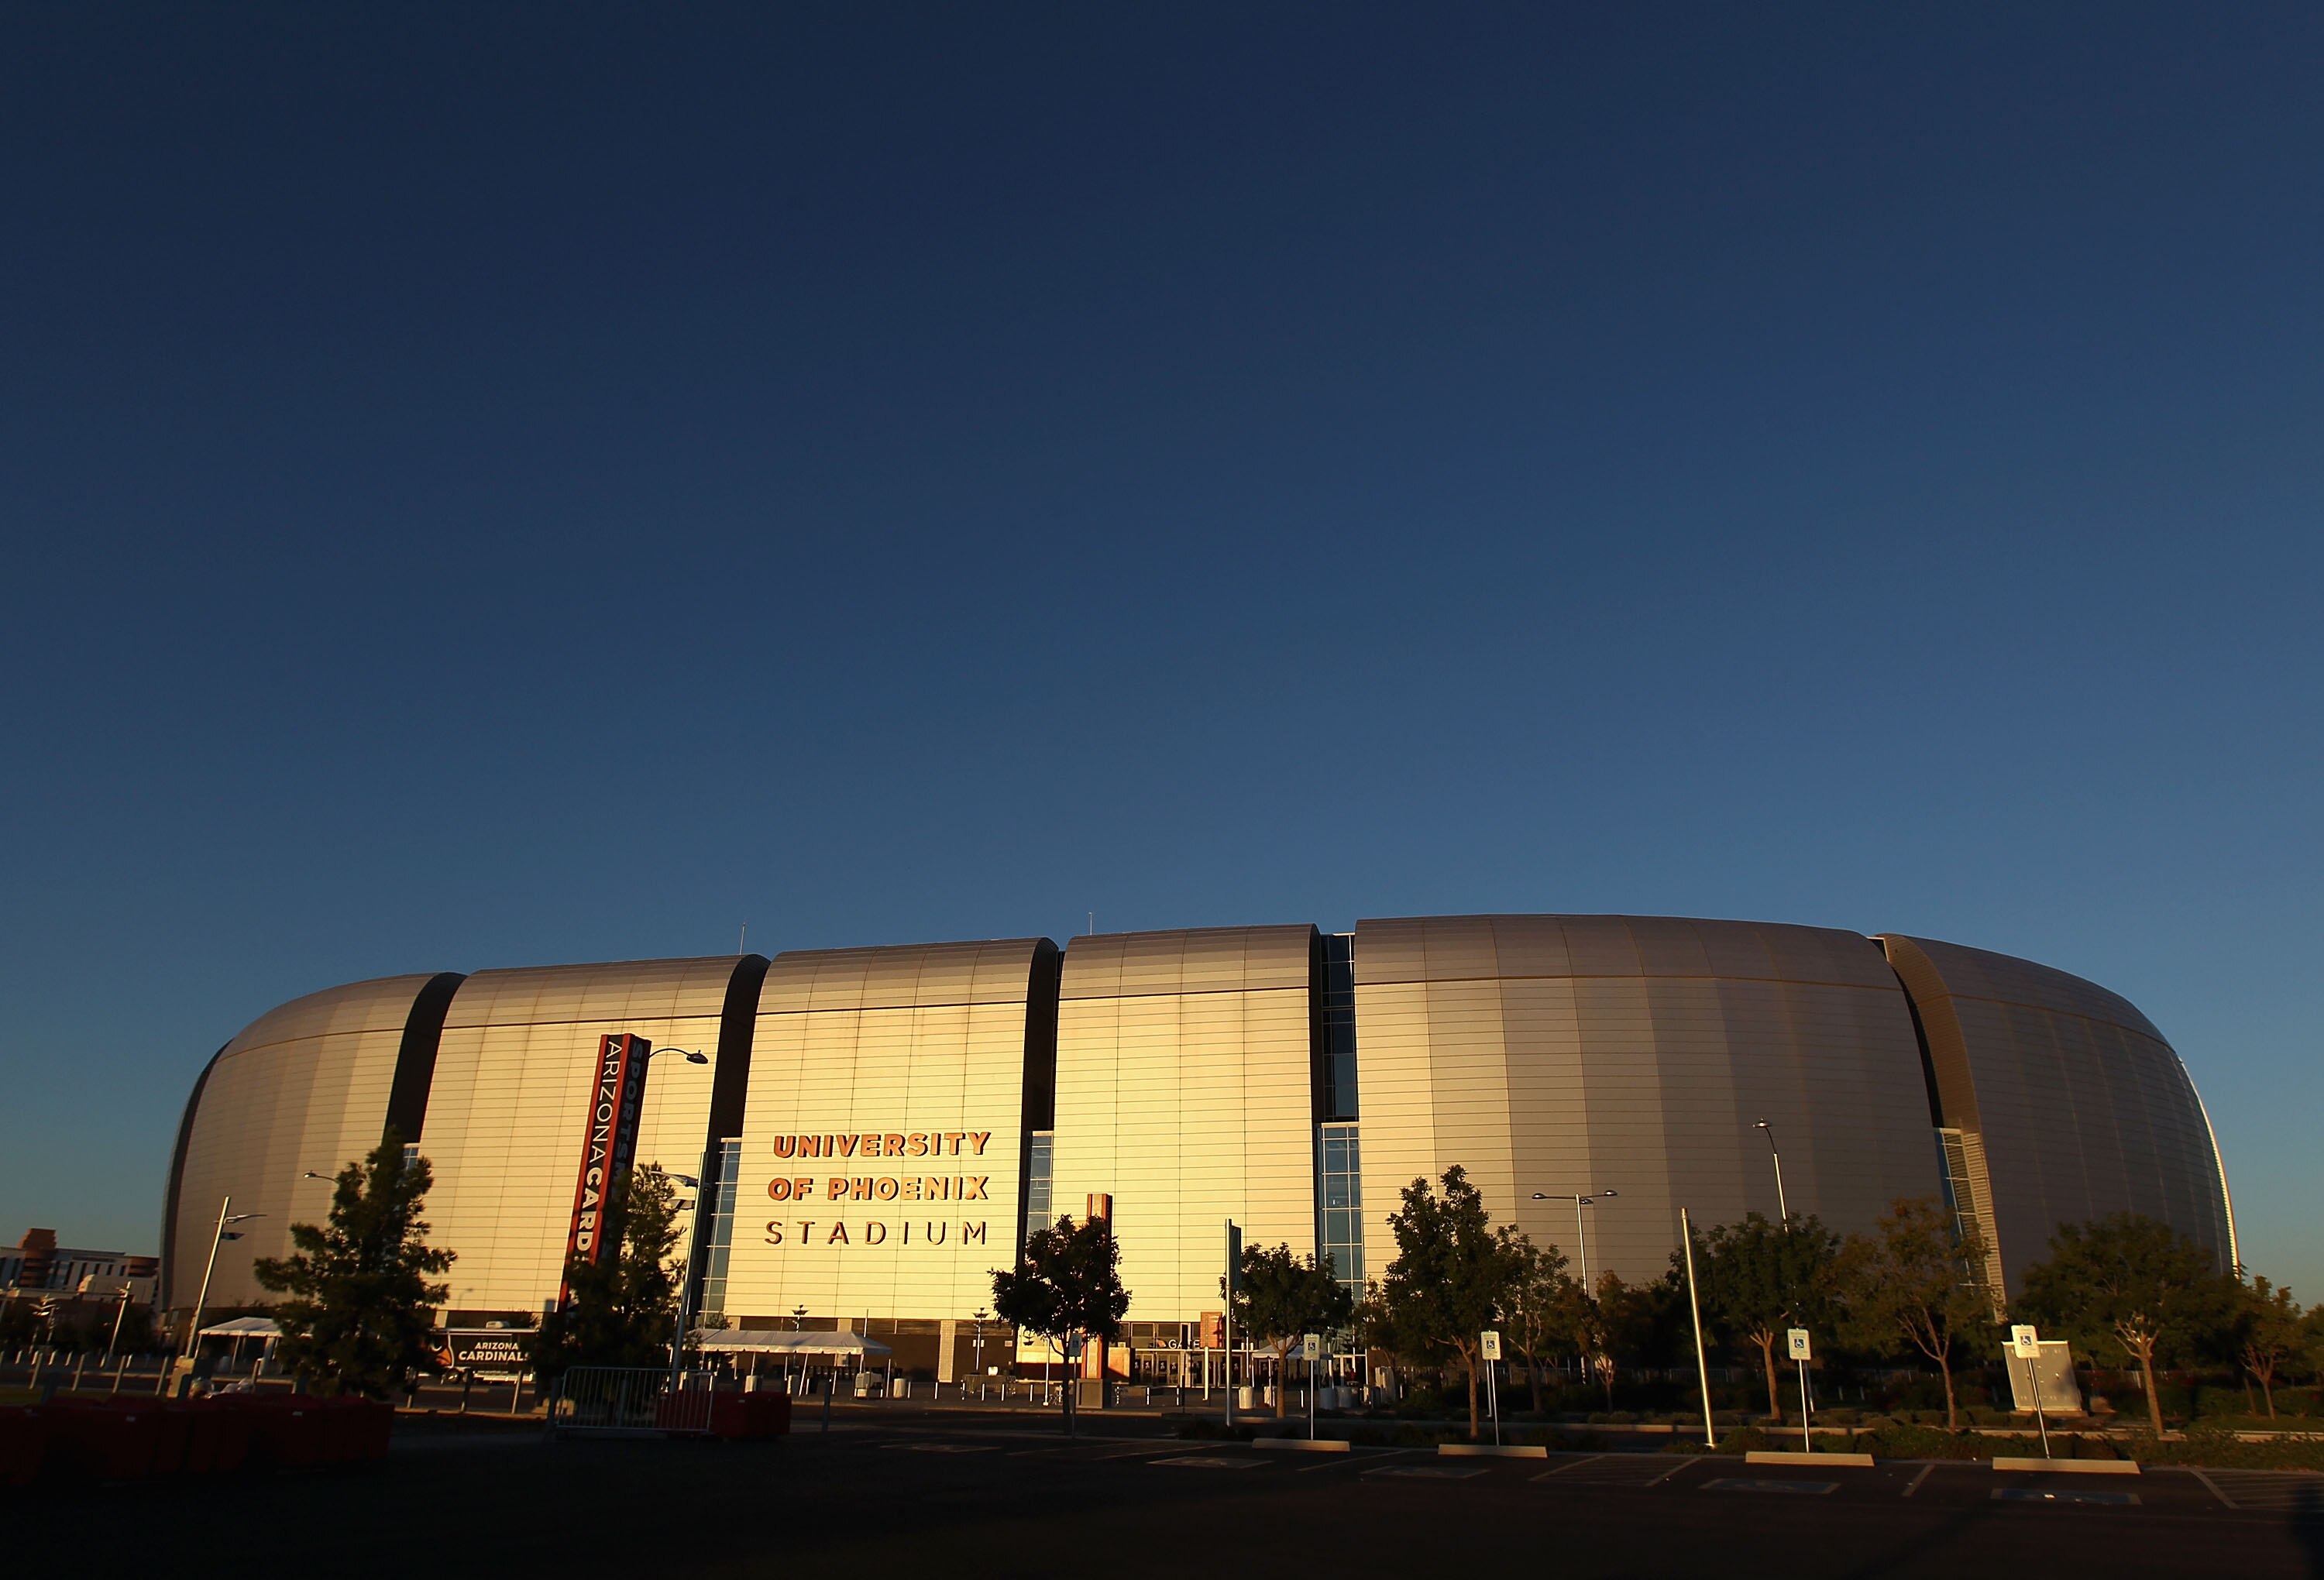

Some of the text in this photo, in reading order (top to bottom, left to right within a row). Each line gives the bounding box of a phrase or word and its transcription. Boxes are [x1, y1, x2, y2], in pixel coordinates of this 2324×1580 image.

[589, 1040, 623, 1163] ARIZONA
[774, 1132, 992, 1159] UNIVERSITY
[768, 1176, 989, 1201] OF PHOENIX
[765, 1221, 987, 1245] STADIUM
[474, 1341, 519, 1350] ARIZONA
